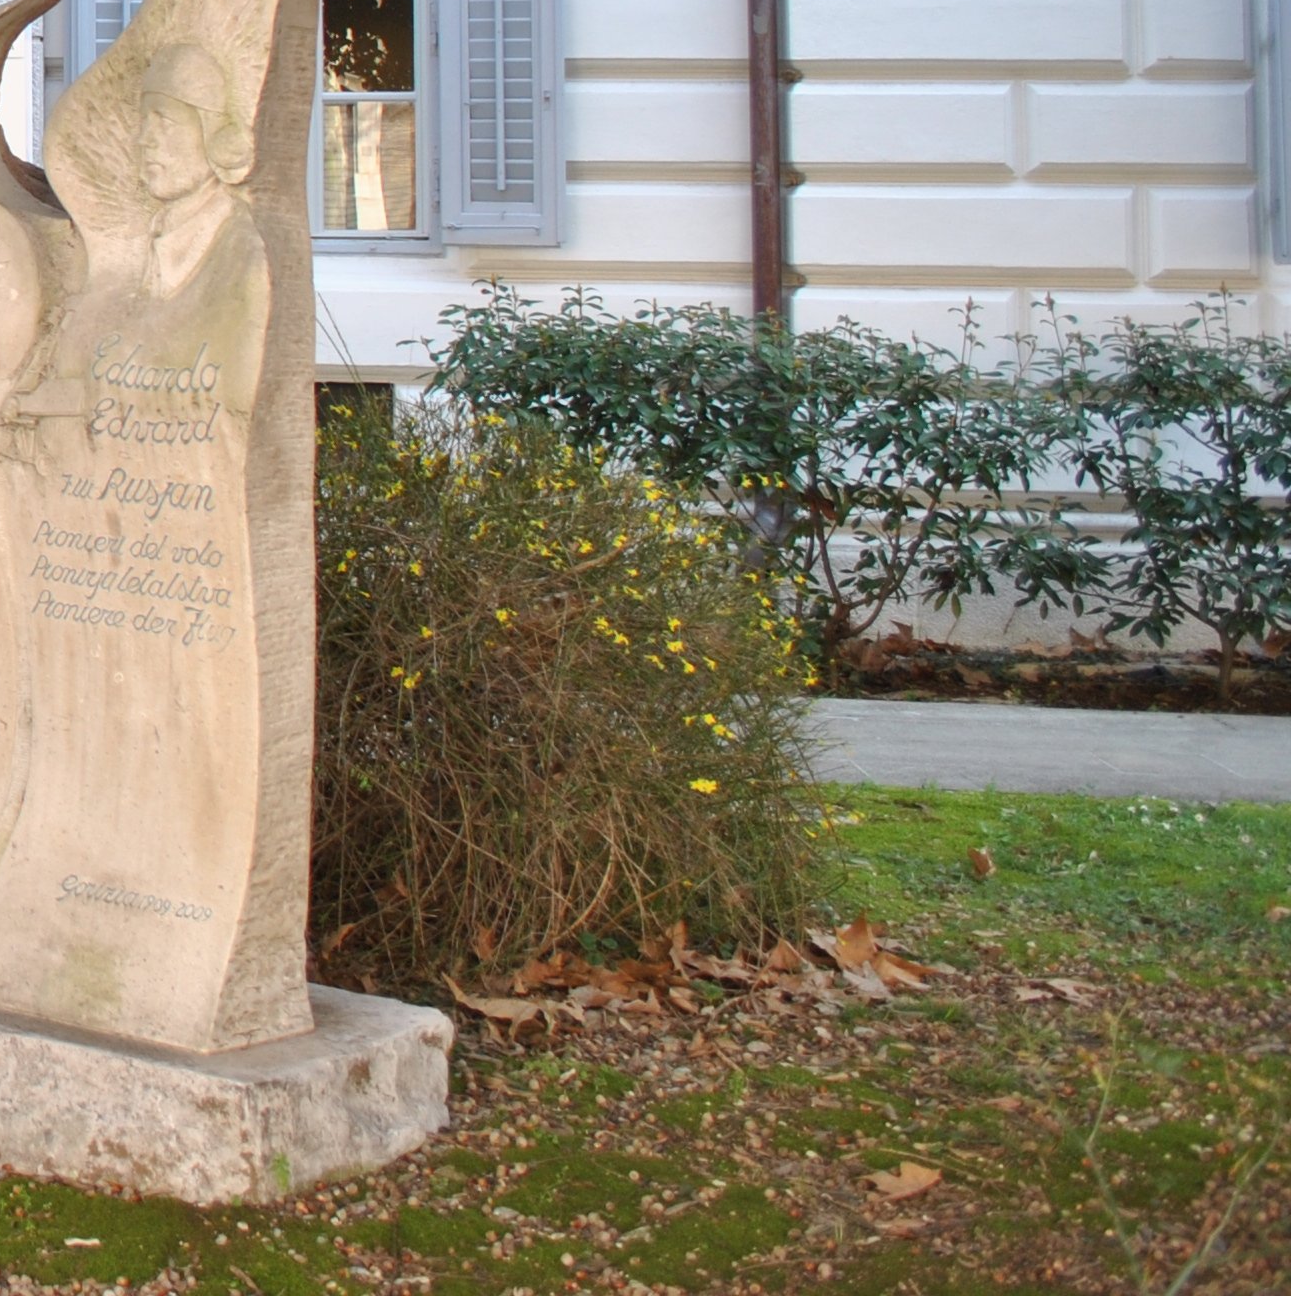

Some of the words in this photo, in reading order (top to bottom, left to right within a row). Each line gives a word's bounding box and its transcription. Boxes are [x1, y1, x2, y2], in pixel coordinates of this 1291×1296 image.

[92, 334, 221, 392] Eduardo
[91, 398, 220, 444] Edvard
[98, 467, 215, 520] Rusjan
[33, 520, 126, 555] Pionieri
[129, 533, 168, 560] del
[172, 540, 223, 568] volo
[32, 589, 127, 628] Pioniere
[132, 606, 179, 636] der
